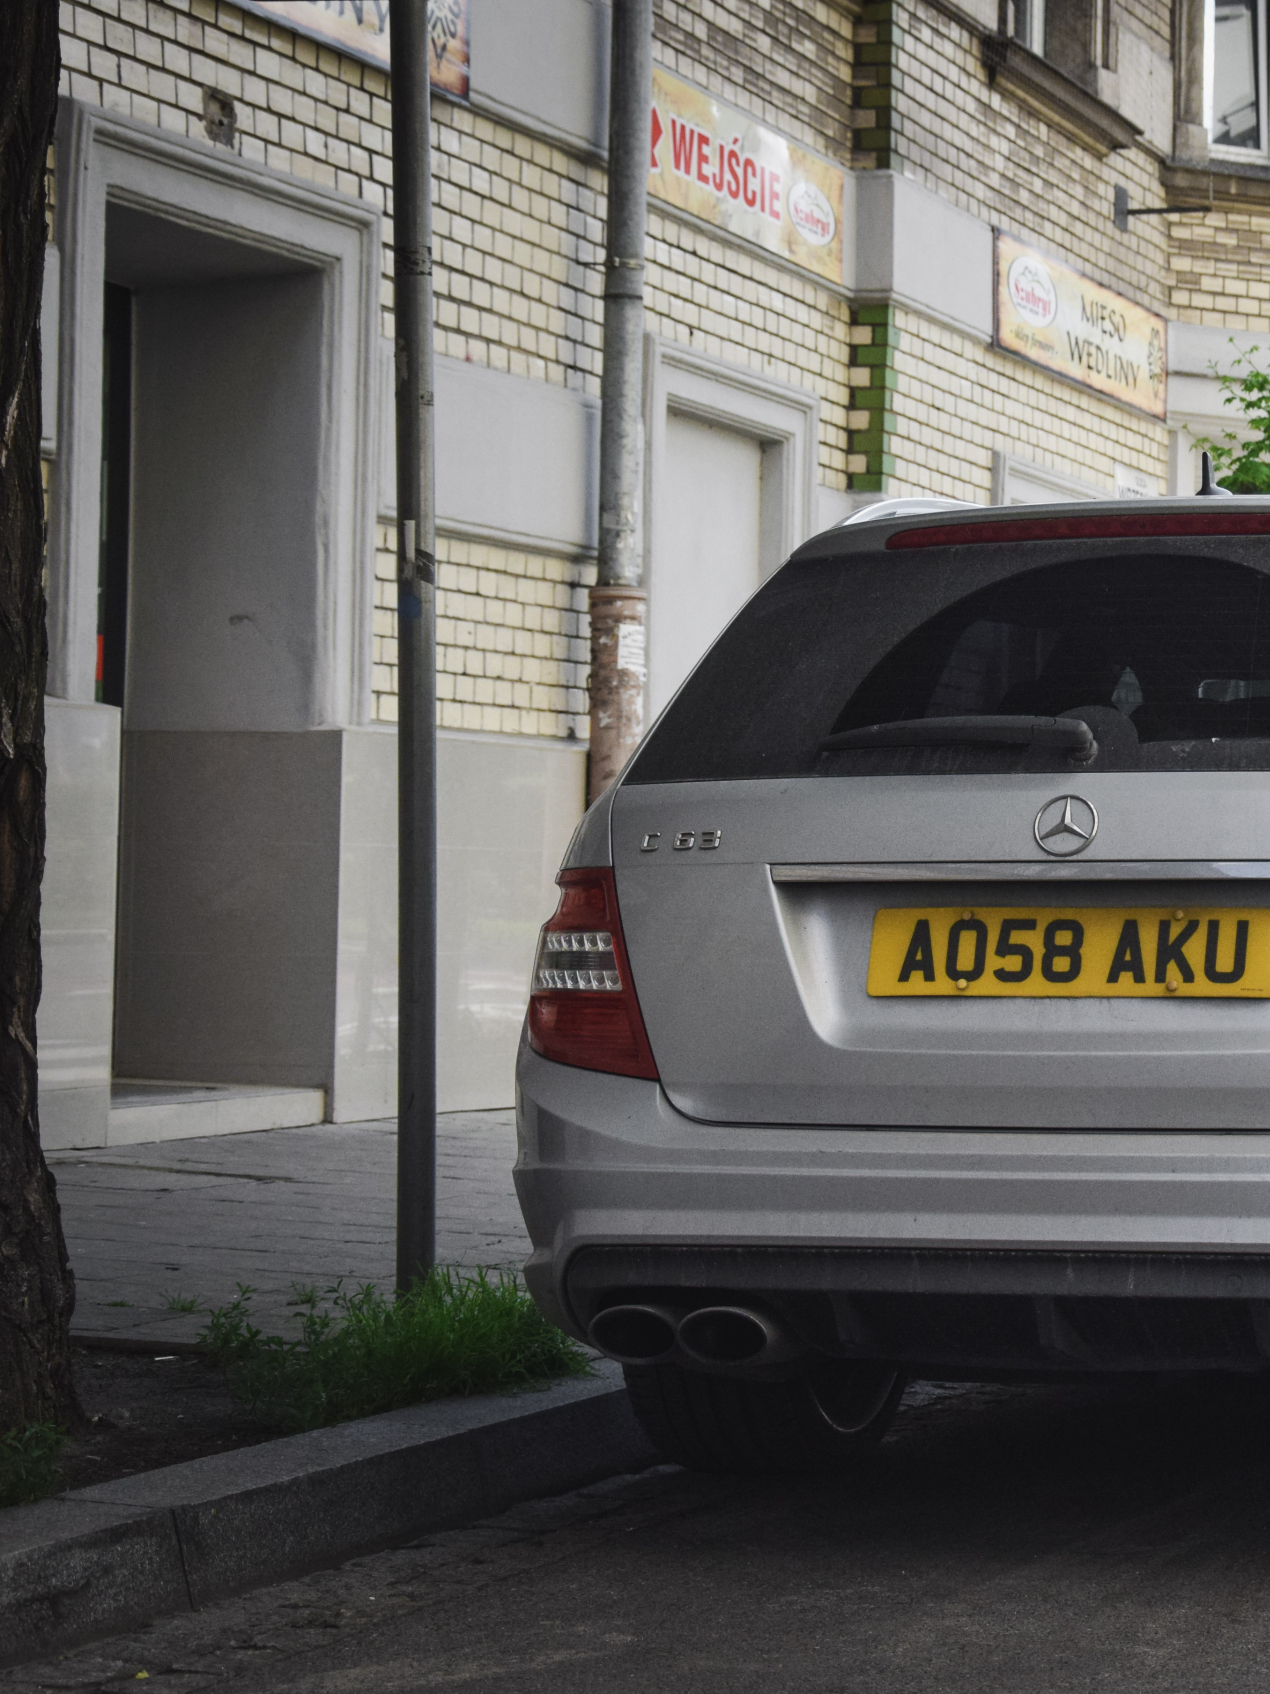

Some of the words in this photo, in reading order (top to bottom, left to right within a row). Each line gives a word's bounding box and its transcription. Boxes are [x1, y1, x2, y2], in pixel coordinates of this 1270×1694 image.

[671, 118, 781, 221] WEJŚCIE
[1013, 278, 1051, 318] Szubryt
[640, 832, 661, 852] C
[673, 830, 721, 851] 63
[898, 918, 1085, 984] AO58
[1106, 918, 1250, 985] AKU
